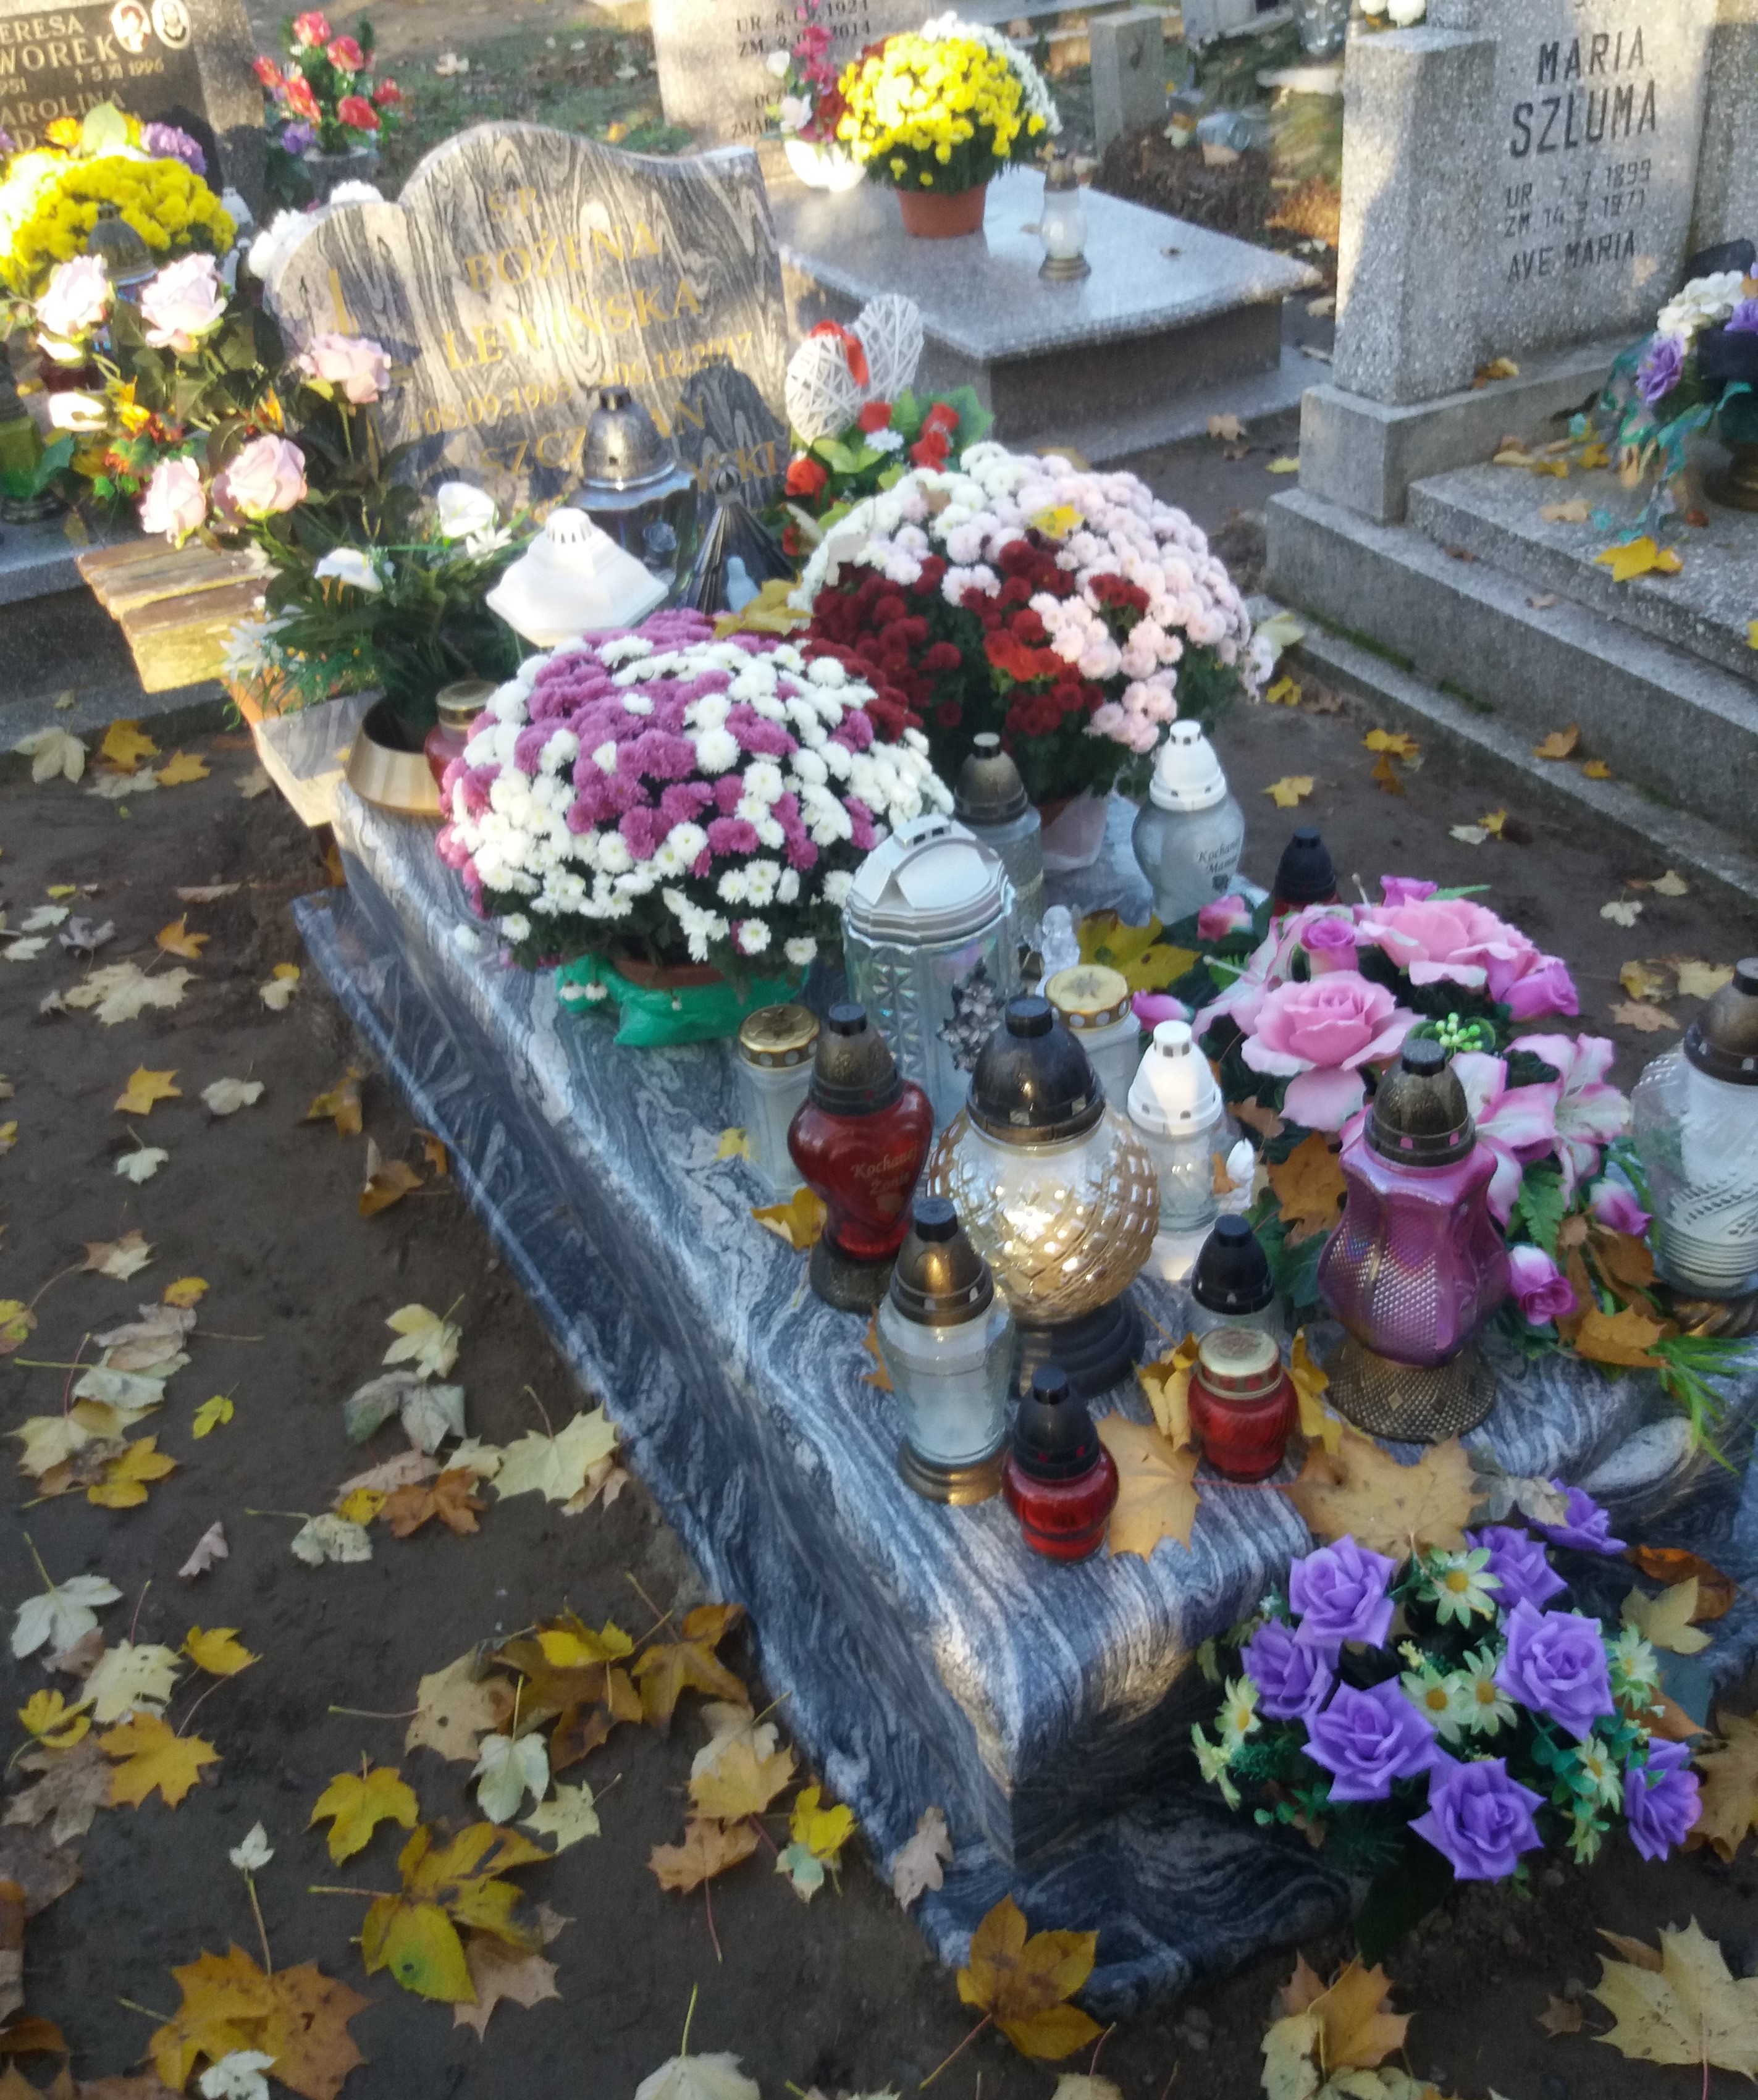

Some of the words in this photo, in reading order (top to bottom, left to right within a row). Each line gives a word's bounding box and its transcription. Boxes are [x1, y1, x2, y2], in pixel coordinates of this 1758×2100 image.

[1536, 25, 1644, 85] MARIA
[1510, 79, 1655, 158] SZLUMA
[465, 220, 660, 292] BOŻENA
[1508, 246, 1554, 282] AVE
[1565, 229, 1634, 268] MARIA
[441, 279, 702, 371] LEWIŃSKA
